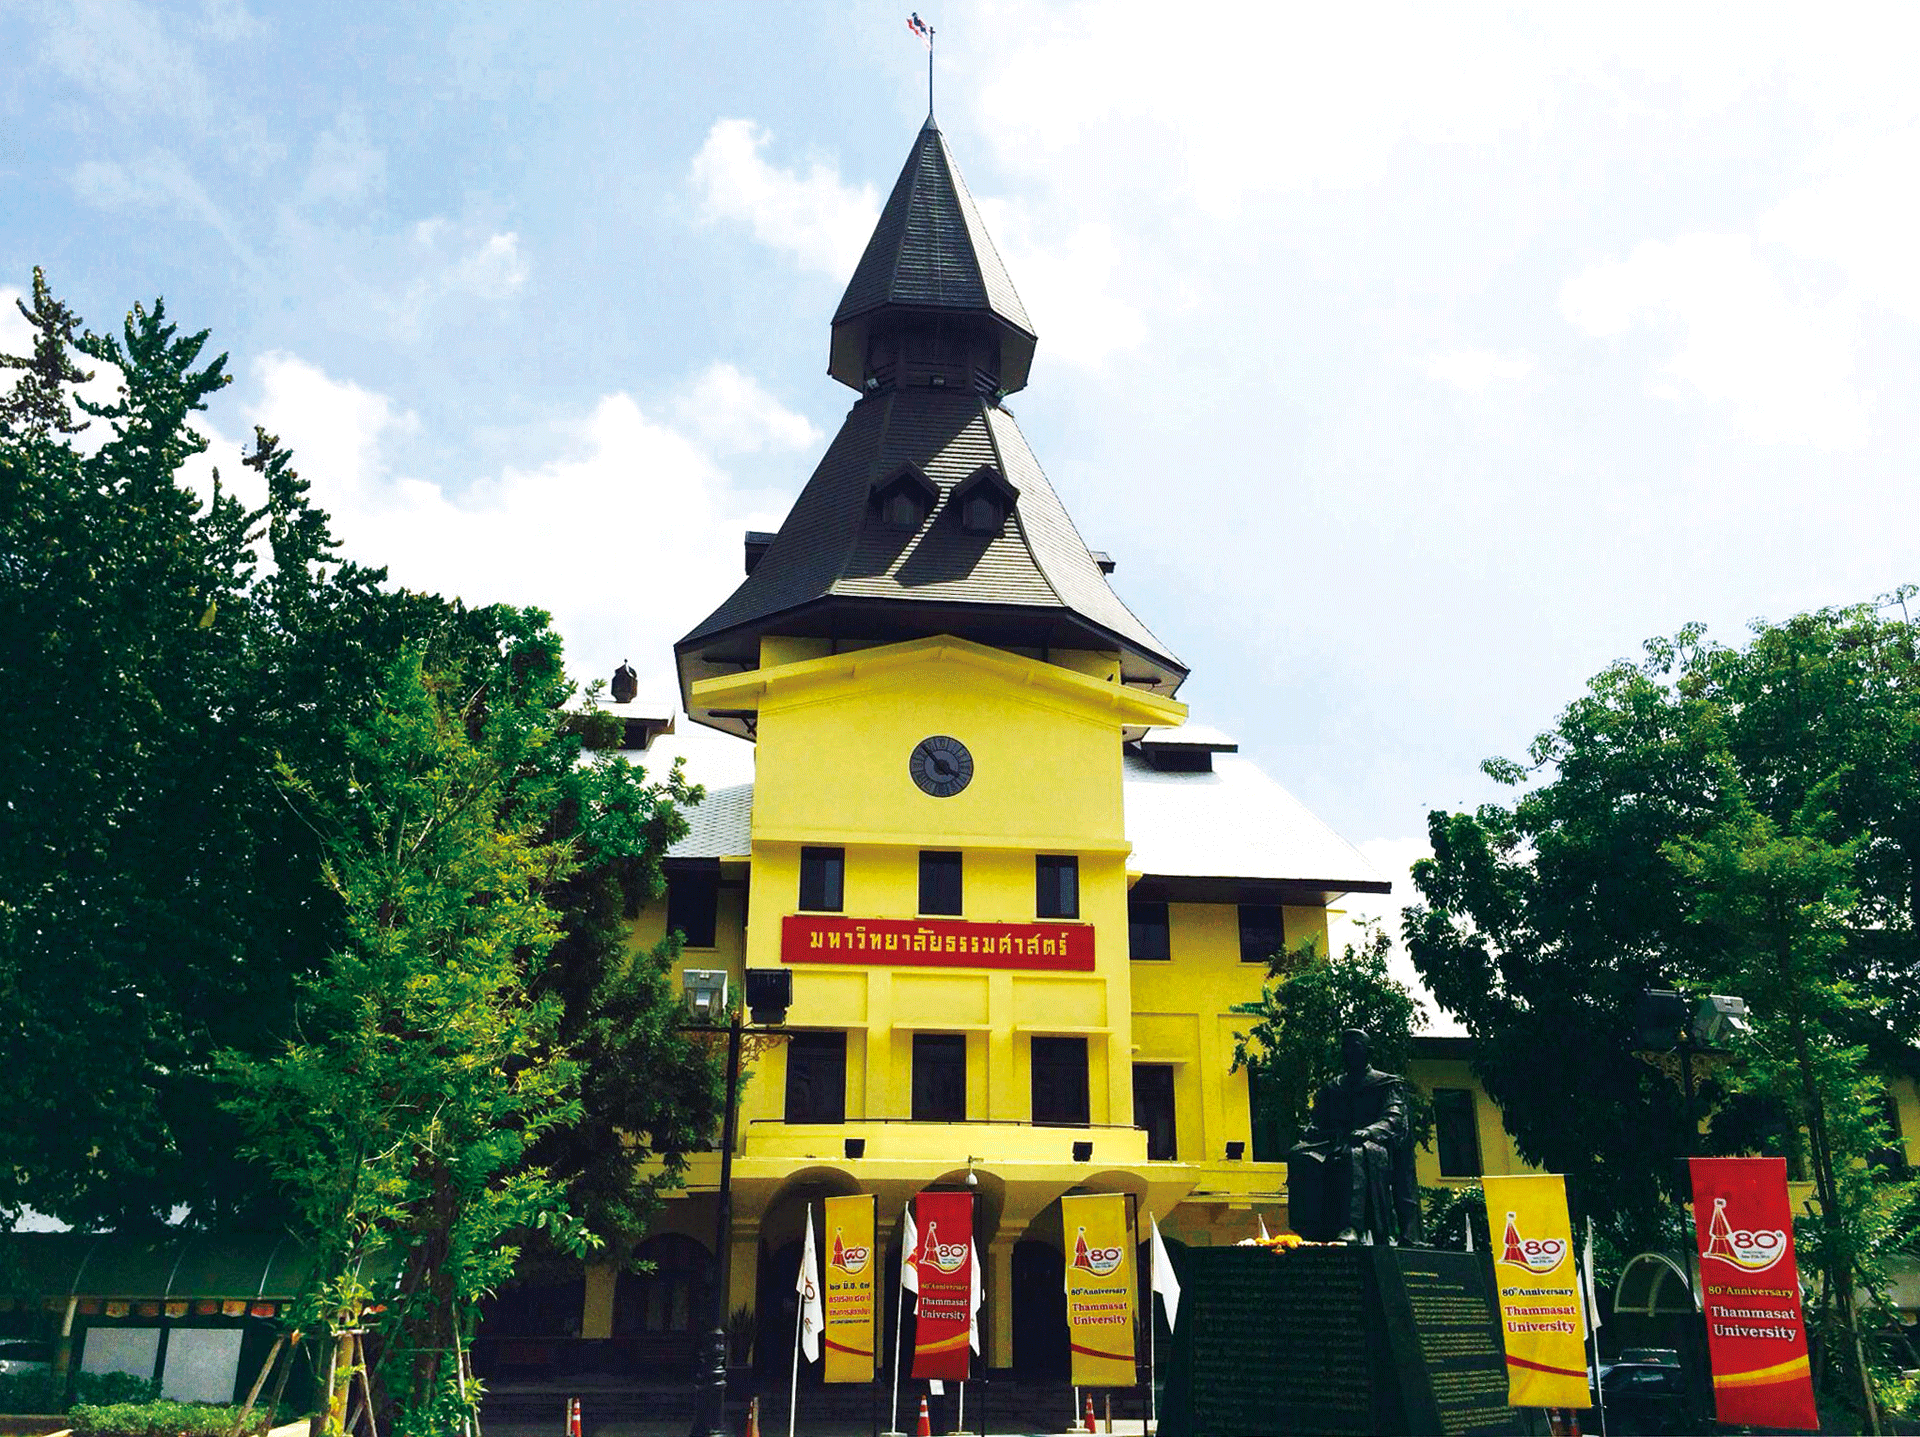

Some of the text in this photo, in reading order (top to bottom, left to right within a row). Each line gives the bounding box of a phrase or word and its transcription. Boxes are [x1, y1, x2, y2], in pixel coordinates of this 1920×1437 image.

[810, 926, 1069, 956] มหาวิทยาลัยธรรมศาสตร์
[1518, 1288, 1574, 1297] Anniversary
[1726, 1286, 1794, 1299] Anniversary
[922, 1297, 968, 1306] Thammasat
[1072, 1302, 1127, 1311] Thammasat
[921, 1310, 966, 1322] University
[1504, 1306, 1576, 1316] Thammasat
[1710, 1306, 1797, 1320] Thammasat
[1073, 1315, 1128, 1325] University
[1507, 1320, 1576, 1334] University
[1713, 1323, 1797, 1342] University
